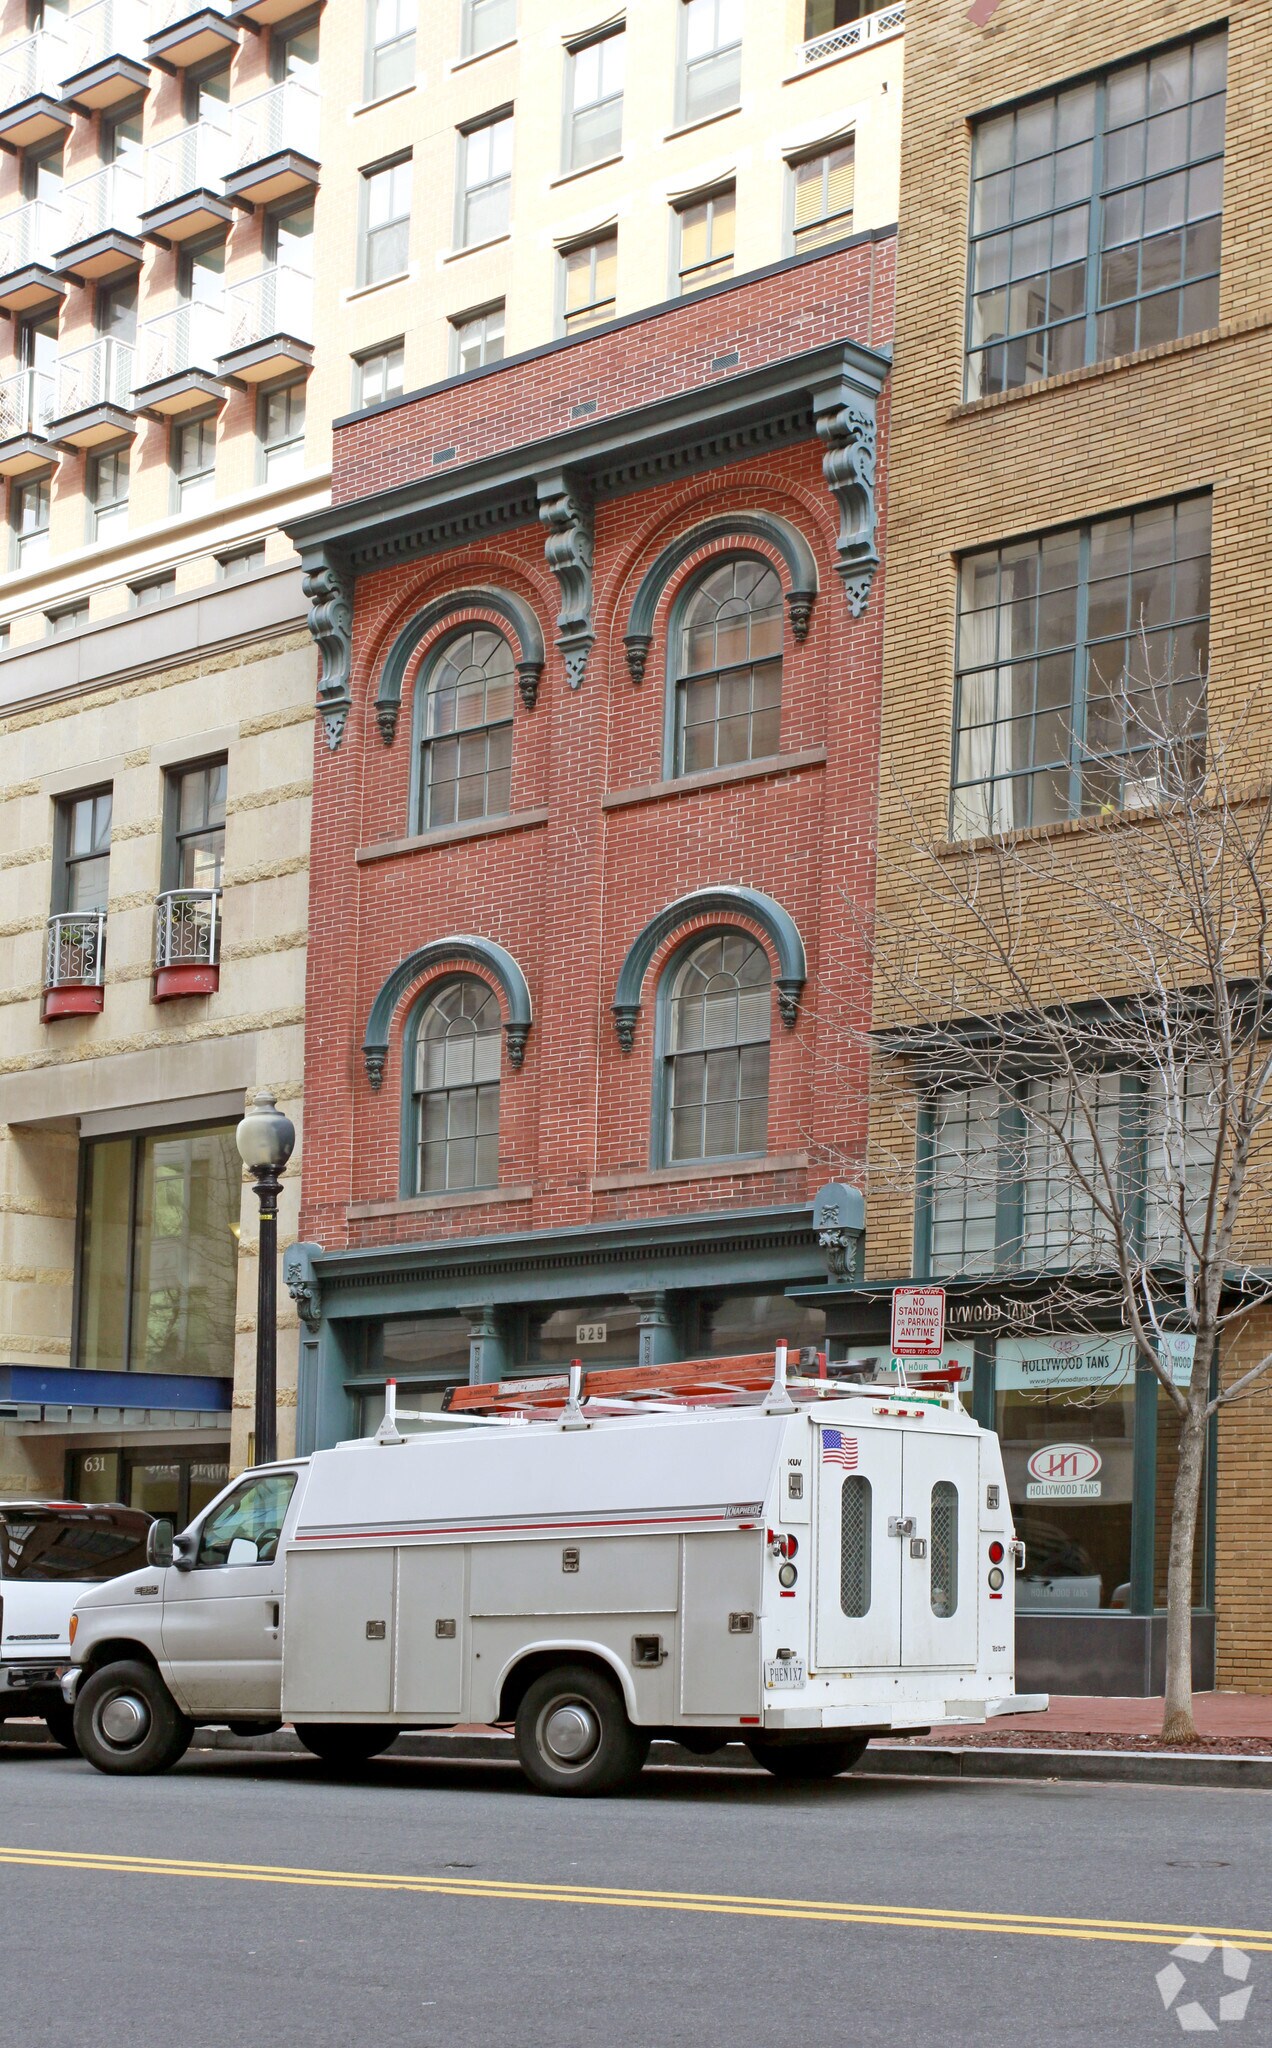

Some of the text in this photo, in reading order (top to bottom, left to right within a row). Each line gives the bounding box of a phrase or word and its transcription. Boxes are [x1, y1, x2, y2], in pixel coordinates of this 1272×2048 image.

[912, 1297, 925, 1306] NO
[898, 1307, 939, 1316] STANDING
[945, 1304, 1001, 1324] LYWOOD
[907, 1318, 940, 1326] PARKING
[579, 1326, 603, 1341] 629
[900, 1328, 935, 1337] ANYTIME
[908, 1363, 929, 1371] HOUR
[1022, 1355, 1110, 1373] HOLLYWOOD TANS
[1029, 1375, 1102, 1385] www.hollywoodtans.com
[84, 1456, 106, 1473] 631
[787, 1458, 802, 1467] KUV
[1030, 1483, 1099, 1496] HOLLYWOOD TANS
[726, 1503, 762, 1517] KNAPHEIDE
[769, 1667, 803, 1682] PHENIX7
